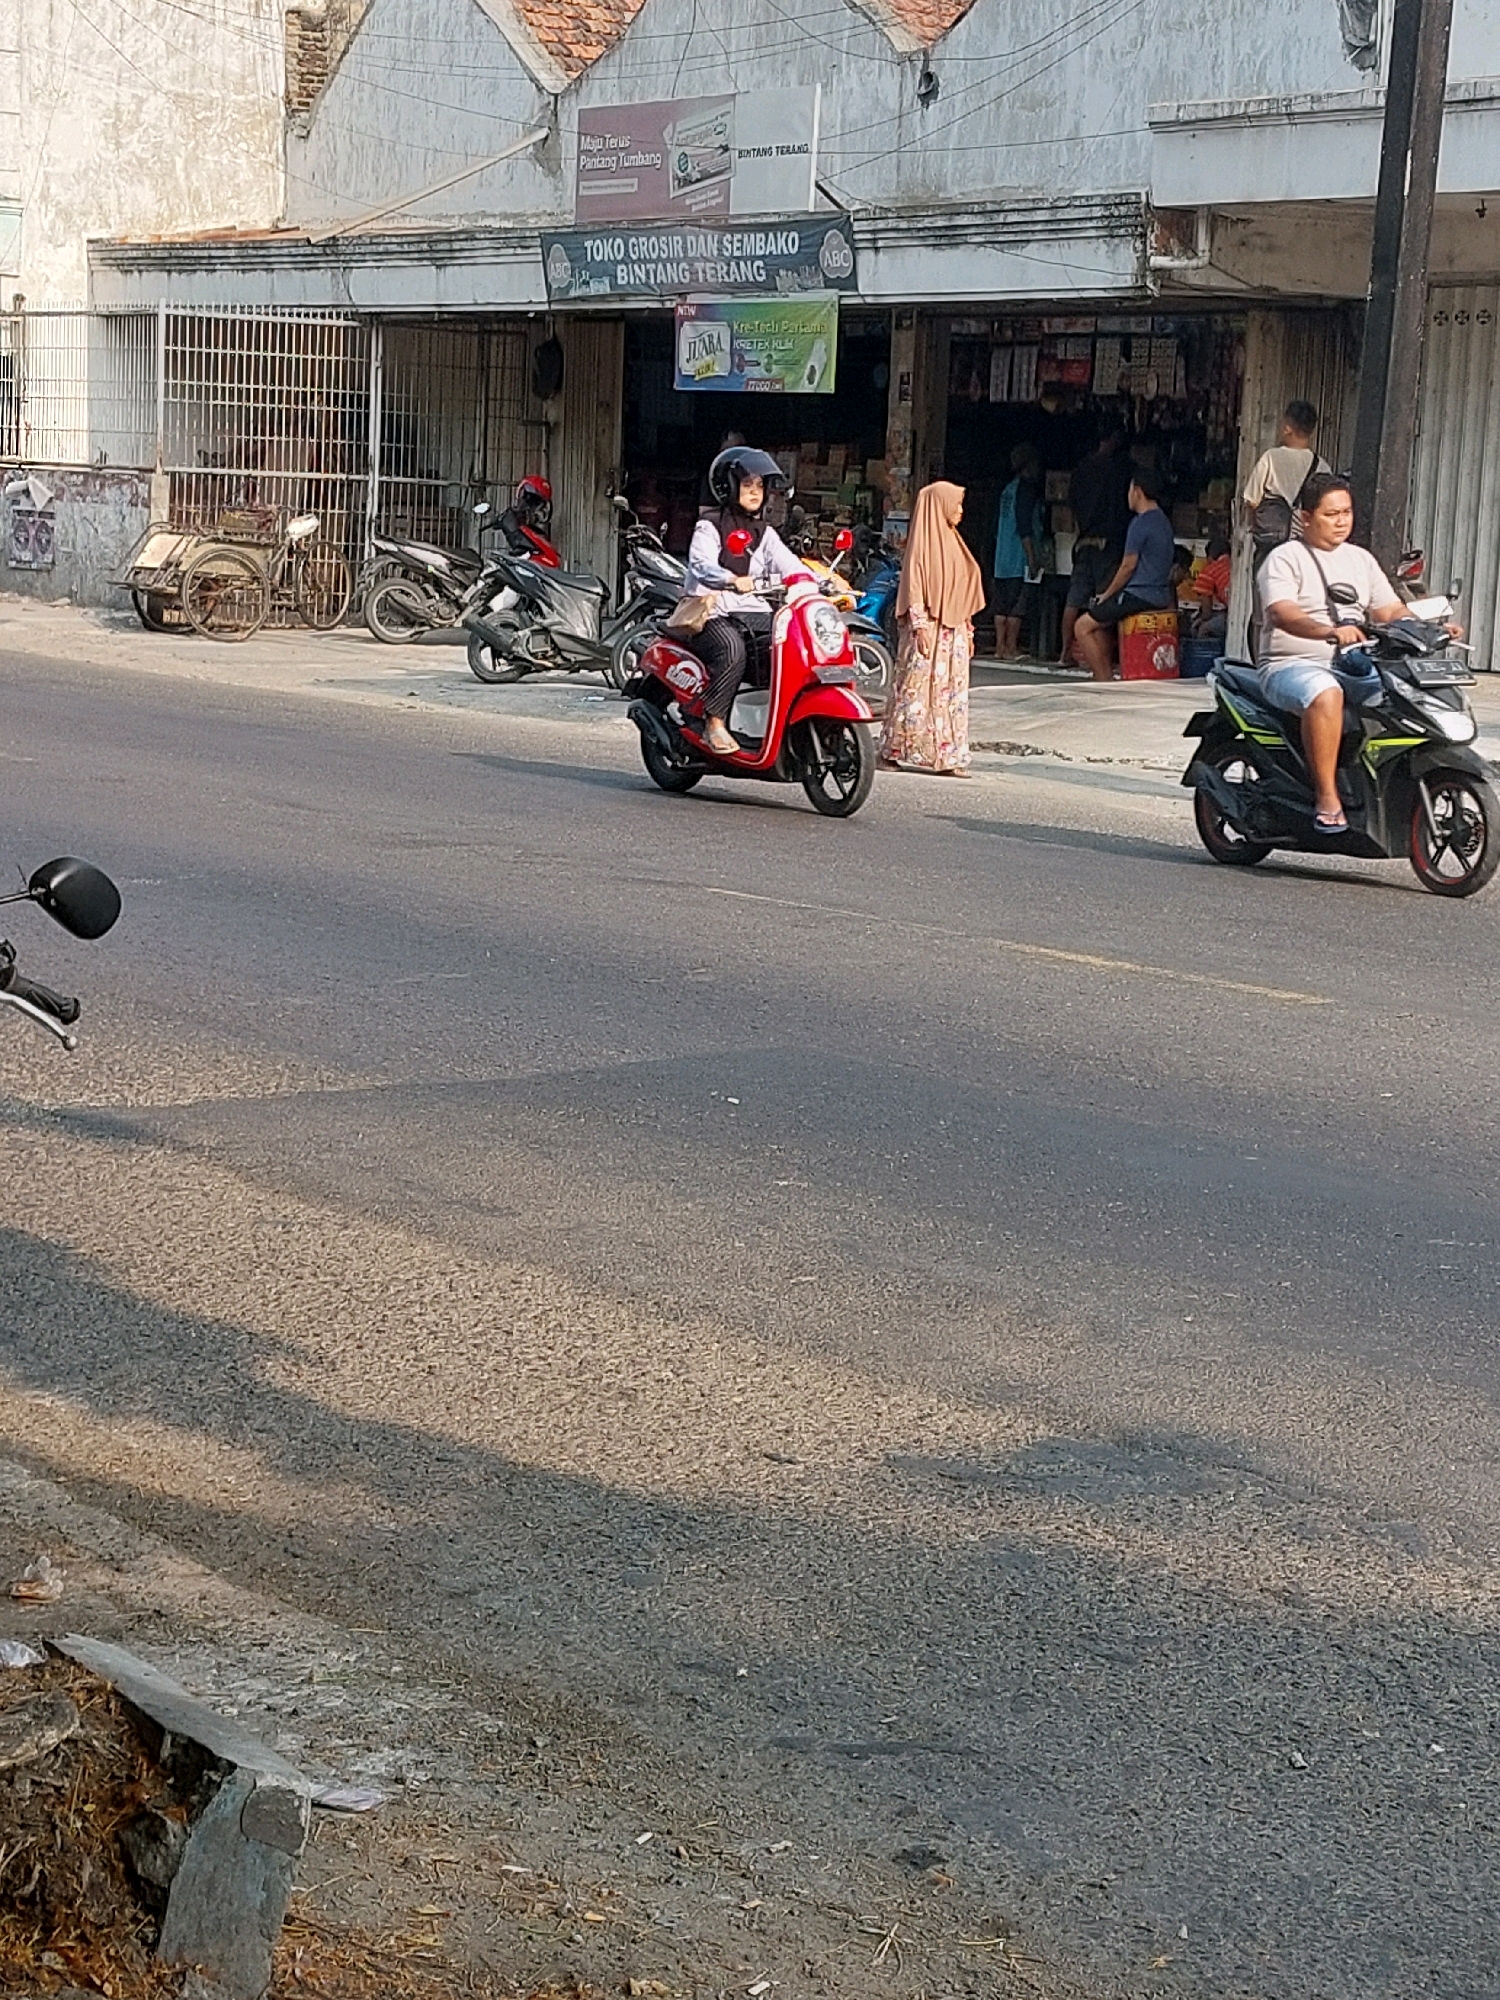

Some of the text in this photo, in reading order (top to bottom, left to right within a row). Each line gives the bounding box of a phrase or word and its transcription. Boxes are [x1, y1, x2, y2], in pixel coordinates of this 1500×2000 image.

[581, 133, 631, 153] Maju Terus
[738, 143, 809, 160] BINTANG TERANG
[580, 151, 662, 173] Pantang Tumbang
[584, 231, 799, 262] TOKO GROSIR DAN SEMBAKO
[824, 249, 849, 268] ABC
[550, 263, 569, 278] ABC
[616, 260, 767, 285] BINTANG TERANG
[677, 305, 696, 317] NEW
[733, 337, 769, 350] KRETEK
